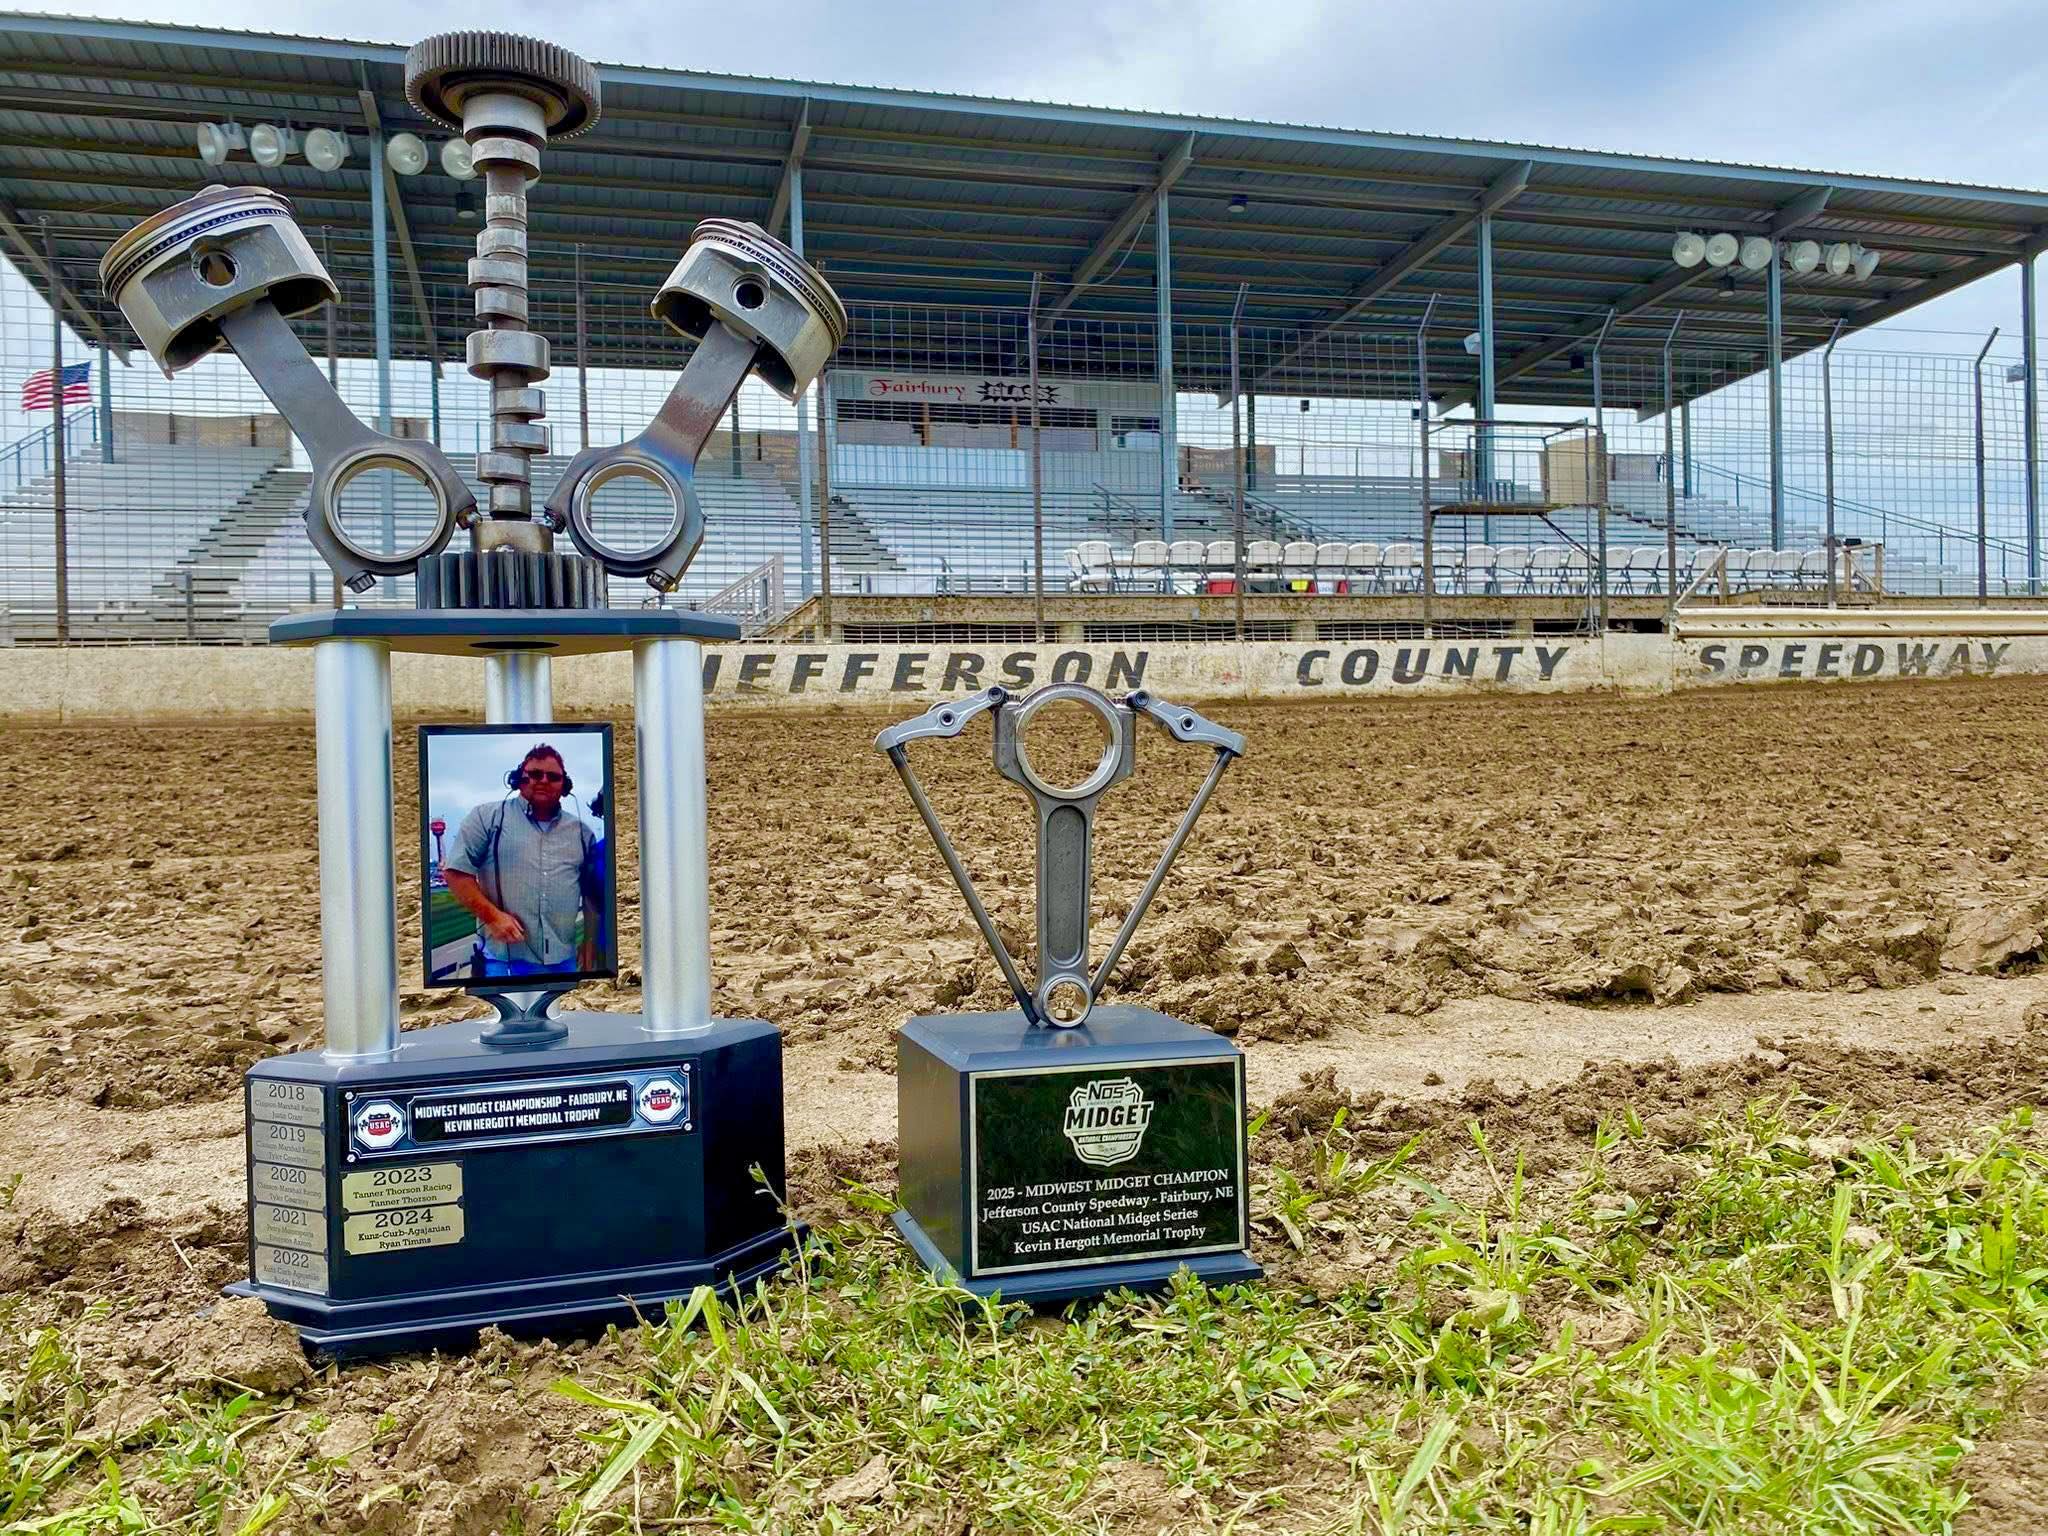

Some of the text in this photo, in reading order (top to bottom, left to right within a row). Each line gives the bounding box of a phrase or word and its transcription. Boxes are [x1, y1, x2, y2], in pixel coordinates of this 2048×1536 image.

[869, 379, 1051, 401] Fairbury GLASS
[1296, 646, 1570, 686] COUNTY
[1699, 643, 2011, 679] SPEEDWAY
[269, 1084, 305, 1101] 2018
[651, 1095, 671, 1105] USAC
[1088, 1082, 1125, 1100] NOS
[415, 1104, 457, 1119] MIDWEST
[459, 1101, 493, 1116] MIDGET
[494, 1095, 561, 1112] CHAMPIONSHIP
[616, 1089, 628, 1102] NE
[370, 1120, 390, 1130] USAC
[444, 1107, 600, 1133] KEVIN HERGOTT MEMORIAL TROPHY
[1066, 1104, 1152, 1129] MIDGET
[270, 1125, 306, 1143] 2019
[271, 1166, 306, 1184] 2020
[373, 1167, 432, 1186] 2023
[987, 1187, 1015, 1201] 2025
[1025, 1180, 1093, 1198] MIDWEST
[1095, 1175, 1151, 1191] MIDGET
[1153, 1168, 1229, 1186] CHAMPION
[353, 1184, 452, 1199] Tanner Thorson Racing
[369, 1194, 437, 1208] Tanner Thorson
[982, 1205, 1039, 1222] Jefferson
[1041, 1201, 1087, 1214] County
[1089, 1195, 1150, 1212] Speedway
[1160, 1190, 1213, 1203] Fairbury,
[1215, 1186, 1234, 1199] NE
[272, 1207, 308, 1226] 2021
[375, 1208, 434, 1228] 2024
[1021, 1208, 1199, 1235] USAC National Midget Series
[358, 1224, 451, 1241] Kunz-Curb-Agajanian
[1013, 1225, 1206, 1254] Kevin Hergott Memorial Trophy
[379, 1237, 432, 1249] Ryan Timms
[273, 1250, 309, 1269] 2022
